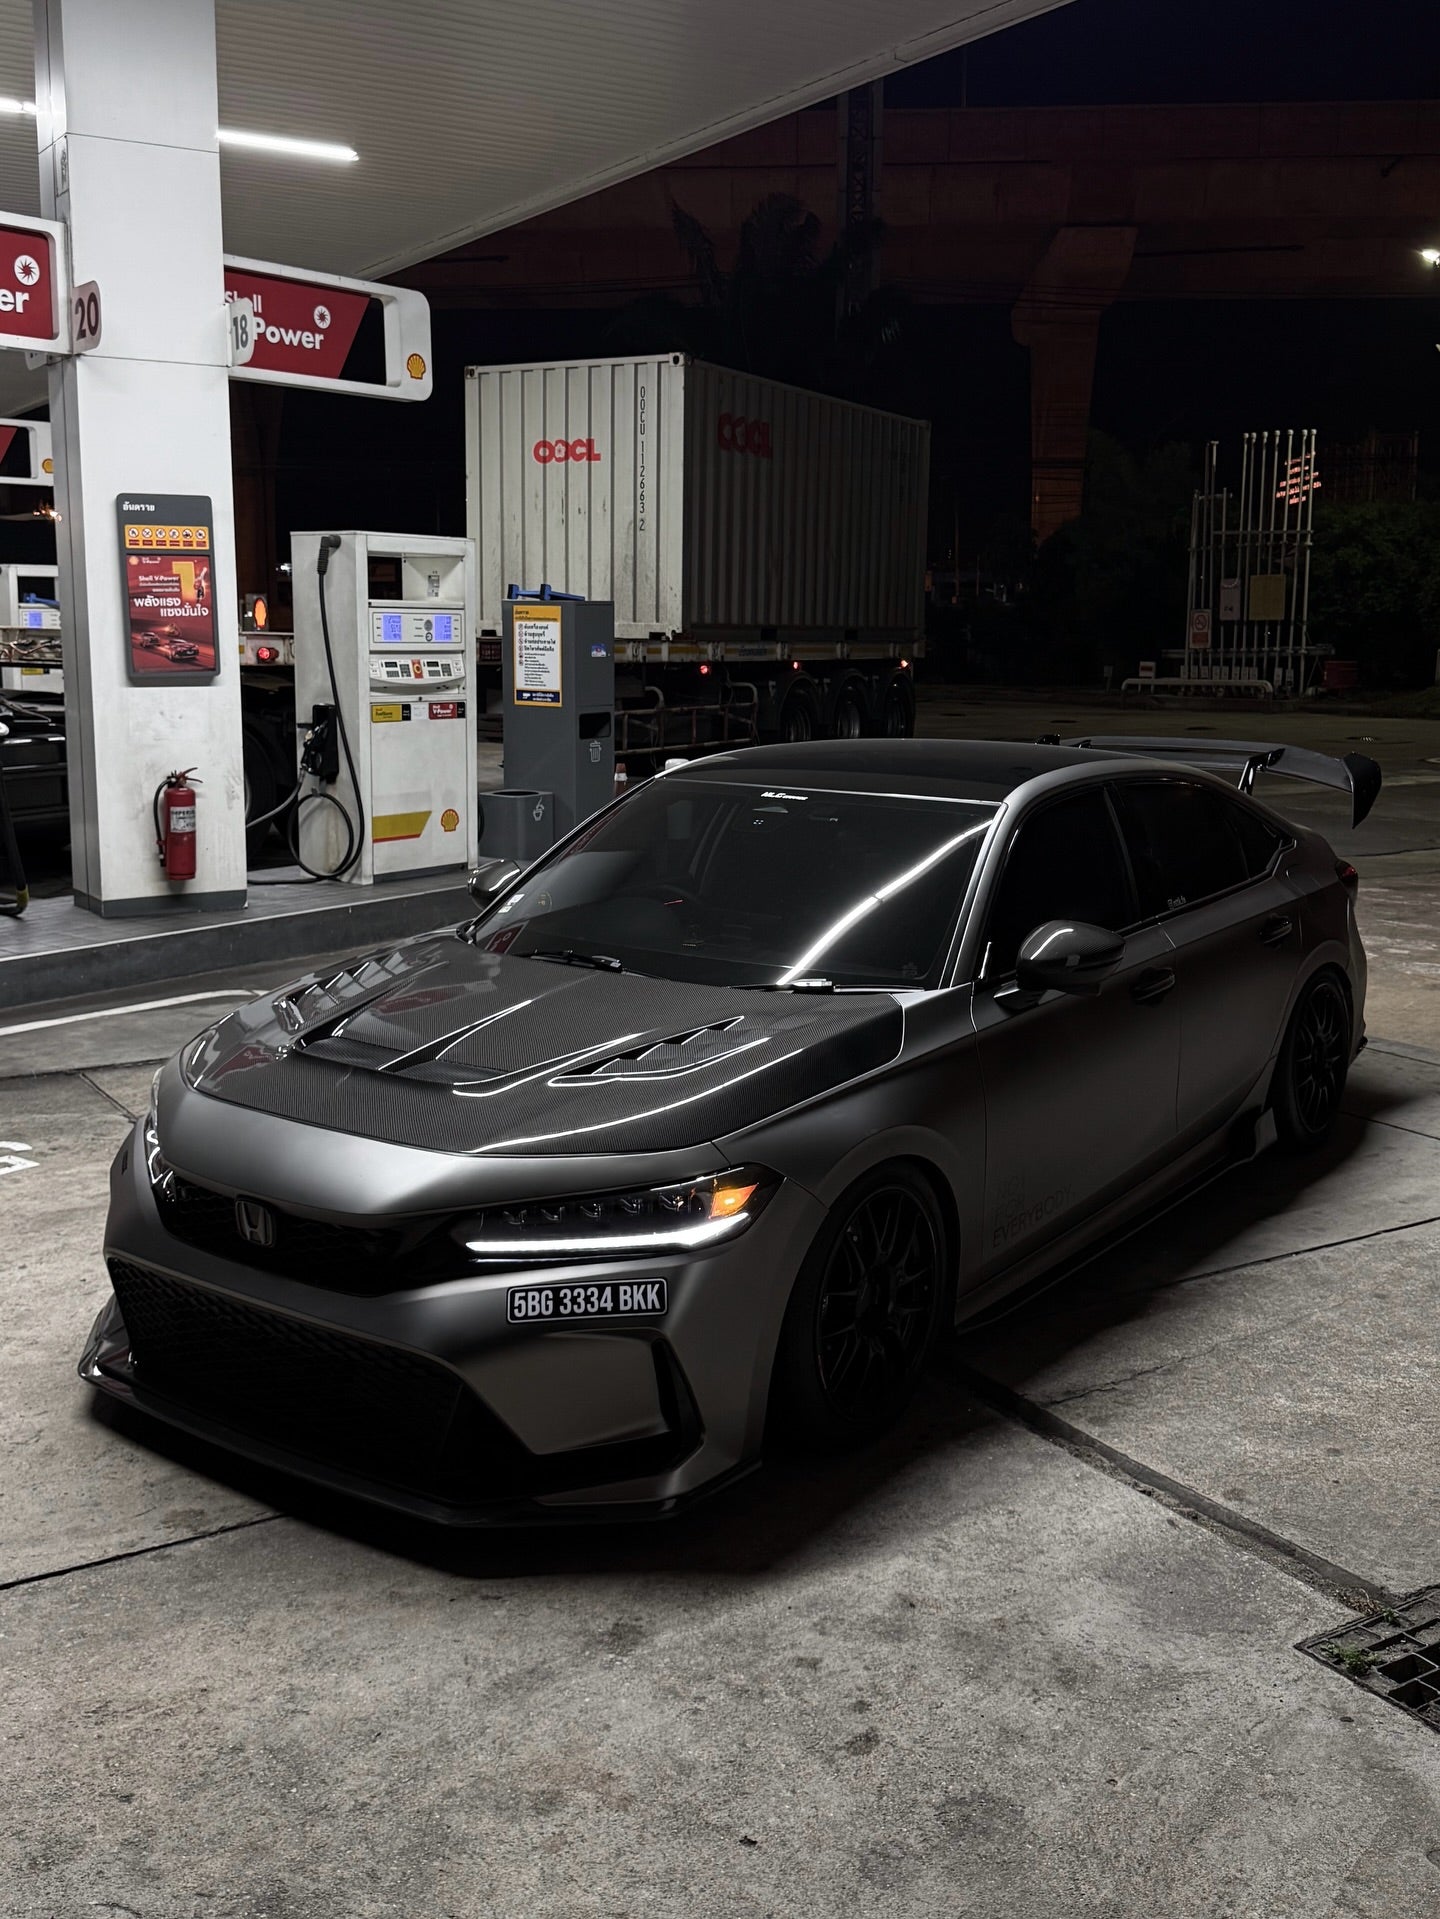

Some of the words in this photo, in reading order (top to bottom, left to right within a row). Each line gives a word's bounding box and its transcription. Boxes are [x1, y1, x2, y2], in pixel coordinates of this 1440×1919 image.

[75, 292, 99, 342] 20
[233, 314, 248, 350] 18
[253, 316, 324, 350] Power
[533, 438, 602, 464] OOCL
[513, 1290, 553, 1318] 5BG
[559, 1287, 613, 1315] 3334
[619, 1283, 661, 1311] BKK
